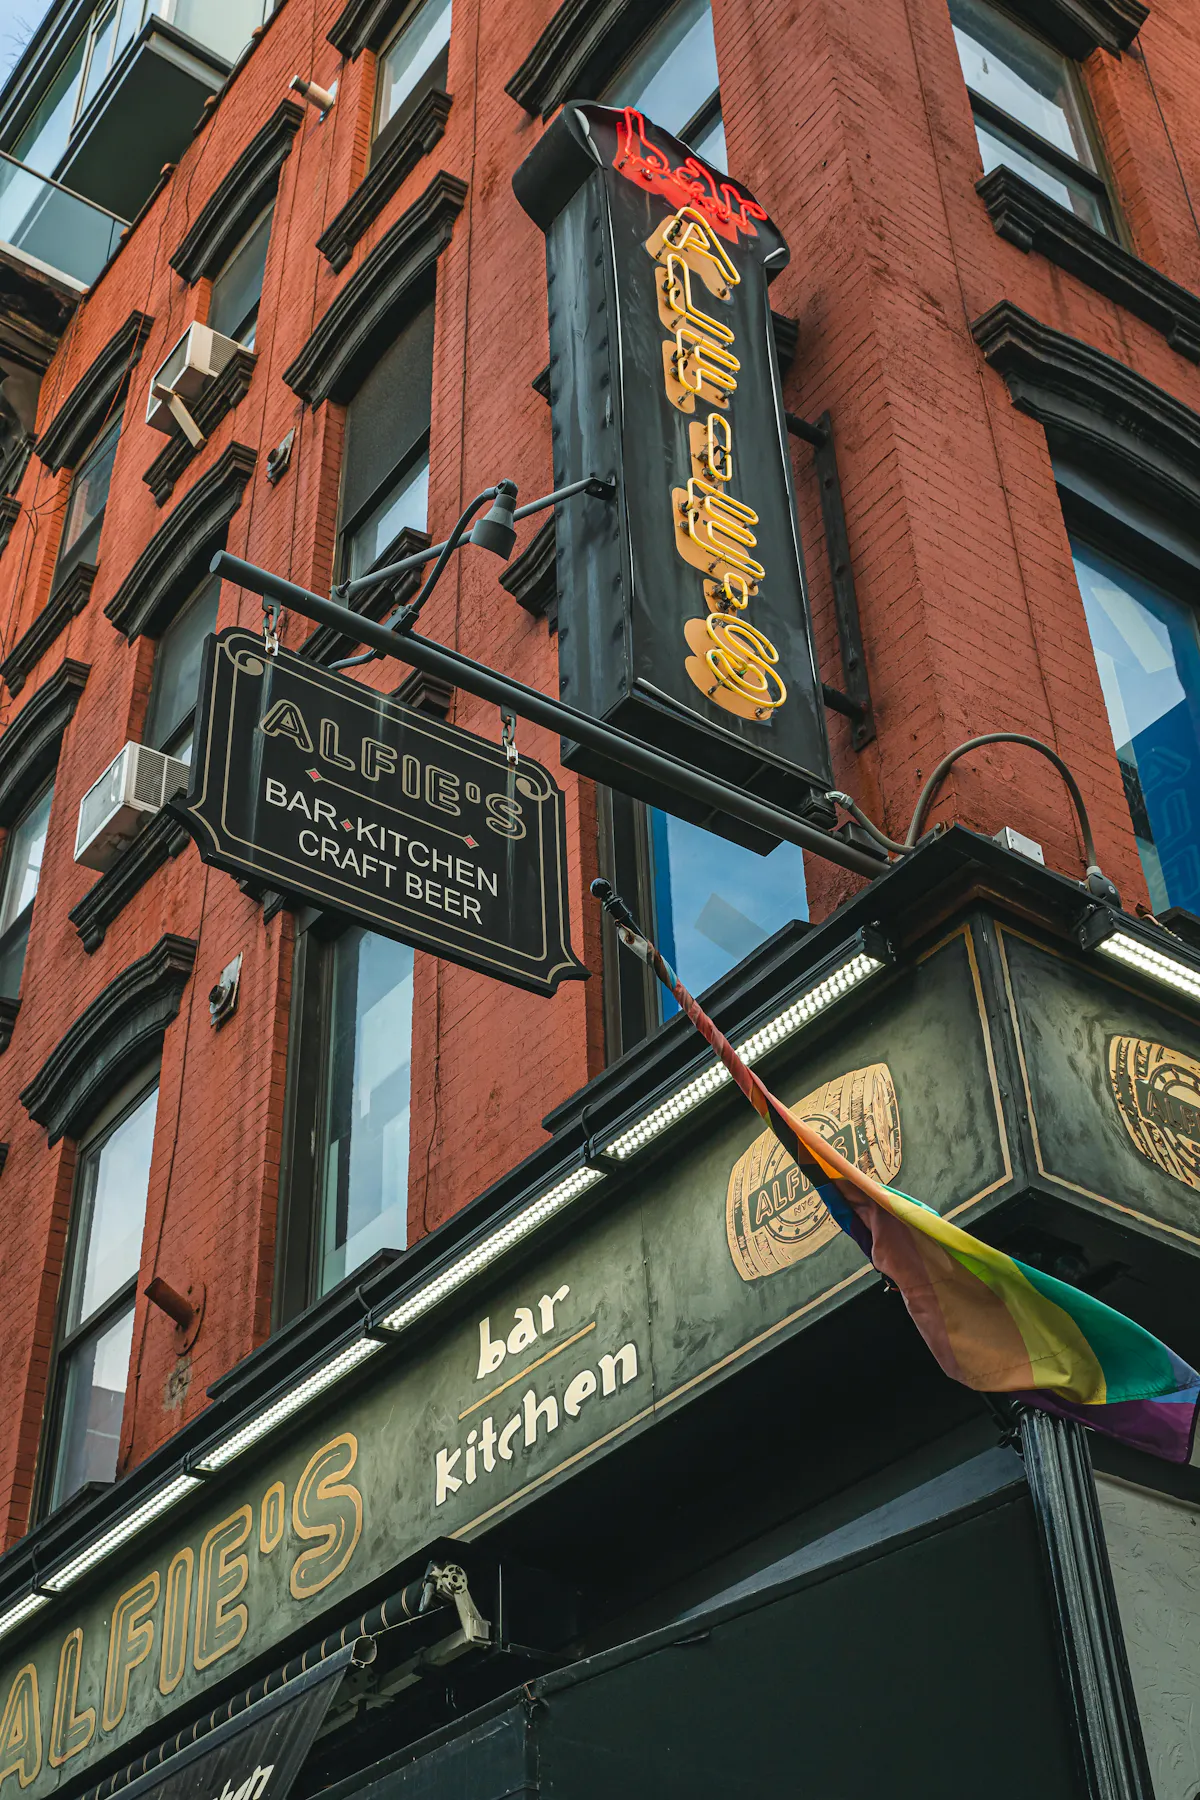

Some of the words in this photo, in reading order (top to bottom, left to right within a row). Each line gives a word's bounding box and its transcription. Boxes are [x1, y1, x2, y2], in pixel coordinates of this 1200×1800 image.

[662, 205, 787, 708] ALFIE'S
[259, 698, 527, 840] ALFIE'S
[265, 777, 338, 831] BAR
[356, 816, 498, 897] KITCHEN
[298, 829, 397, 888] CRAFT
[405, 870, 483, 925] BEER
[793, 1195, 815, 1217] NYC
[476, 1284, 571, 1380] bar
[435, 1342, 638, 1507] kitchen
[0, 1432, 363, 1789] ALFIE'S
